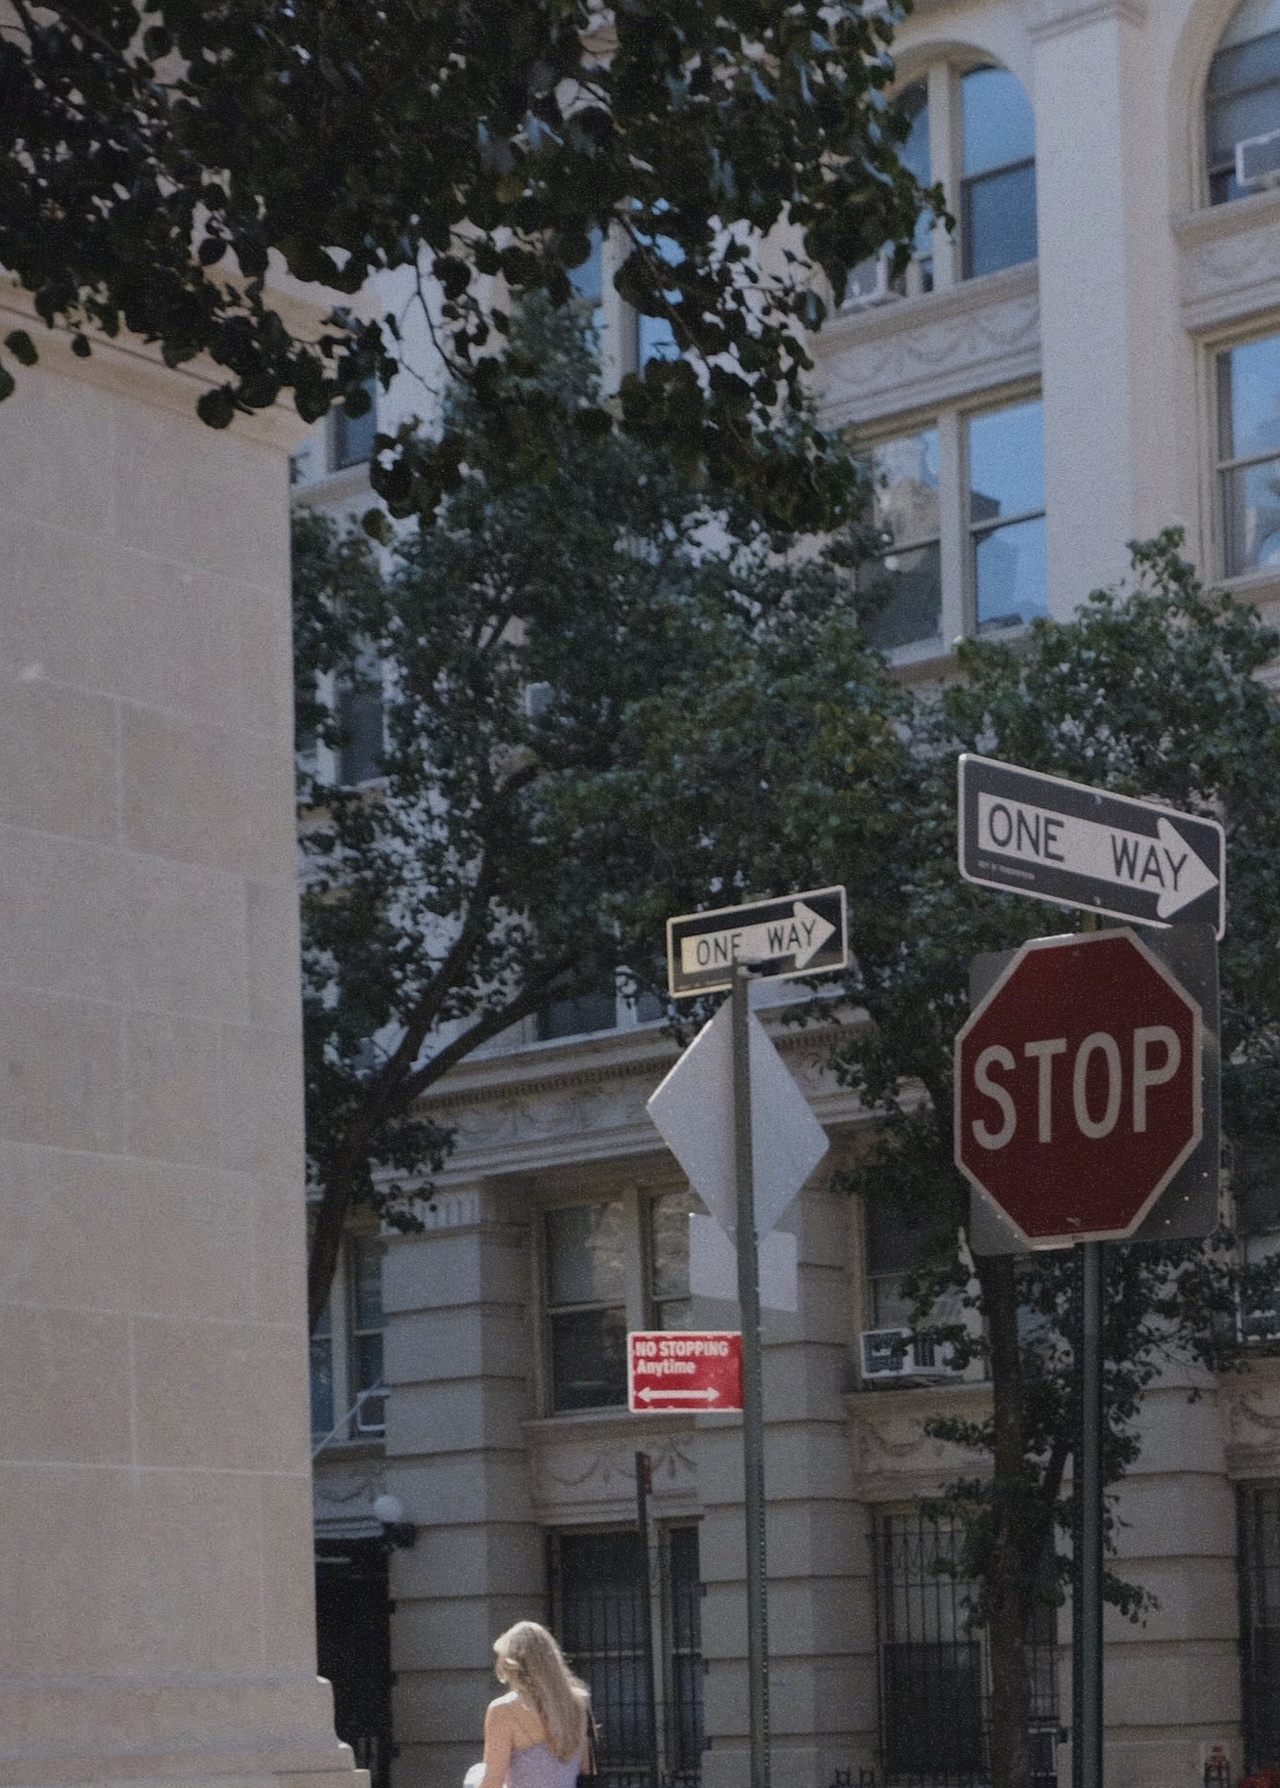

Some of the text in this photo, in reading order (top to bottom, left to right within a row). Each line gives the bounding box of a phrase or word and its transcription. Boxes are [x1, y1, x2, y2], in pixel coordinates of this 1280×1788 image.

[988, 802, 1188, 892] ONE WAY
[696, 919, 816, 966] ONE WAY
[971, 1025, 1182, 1151] STOP
[635, 1340, 729, 1357] NO STOPPING
[637, 1358, 697, 1377] Anytime
